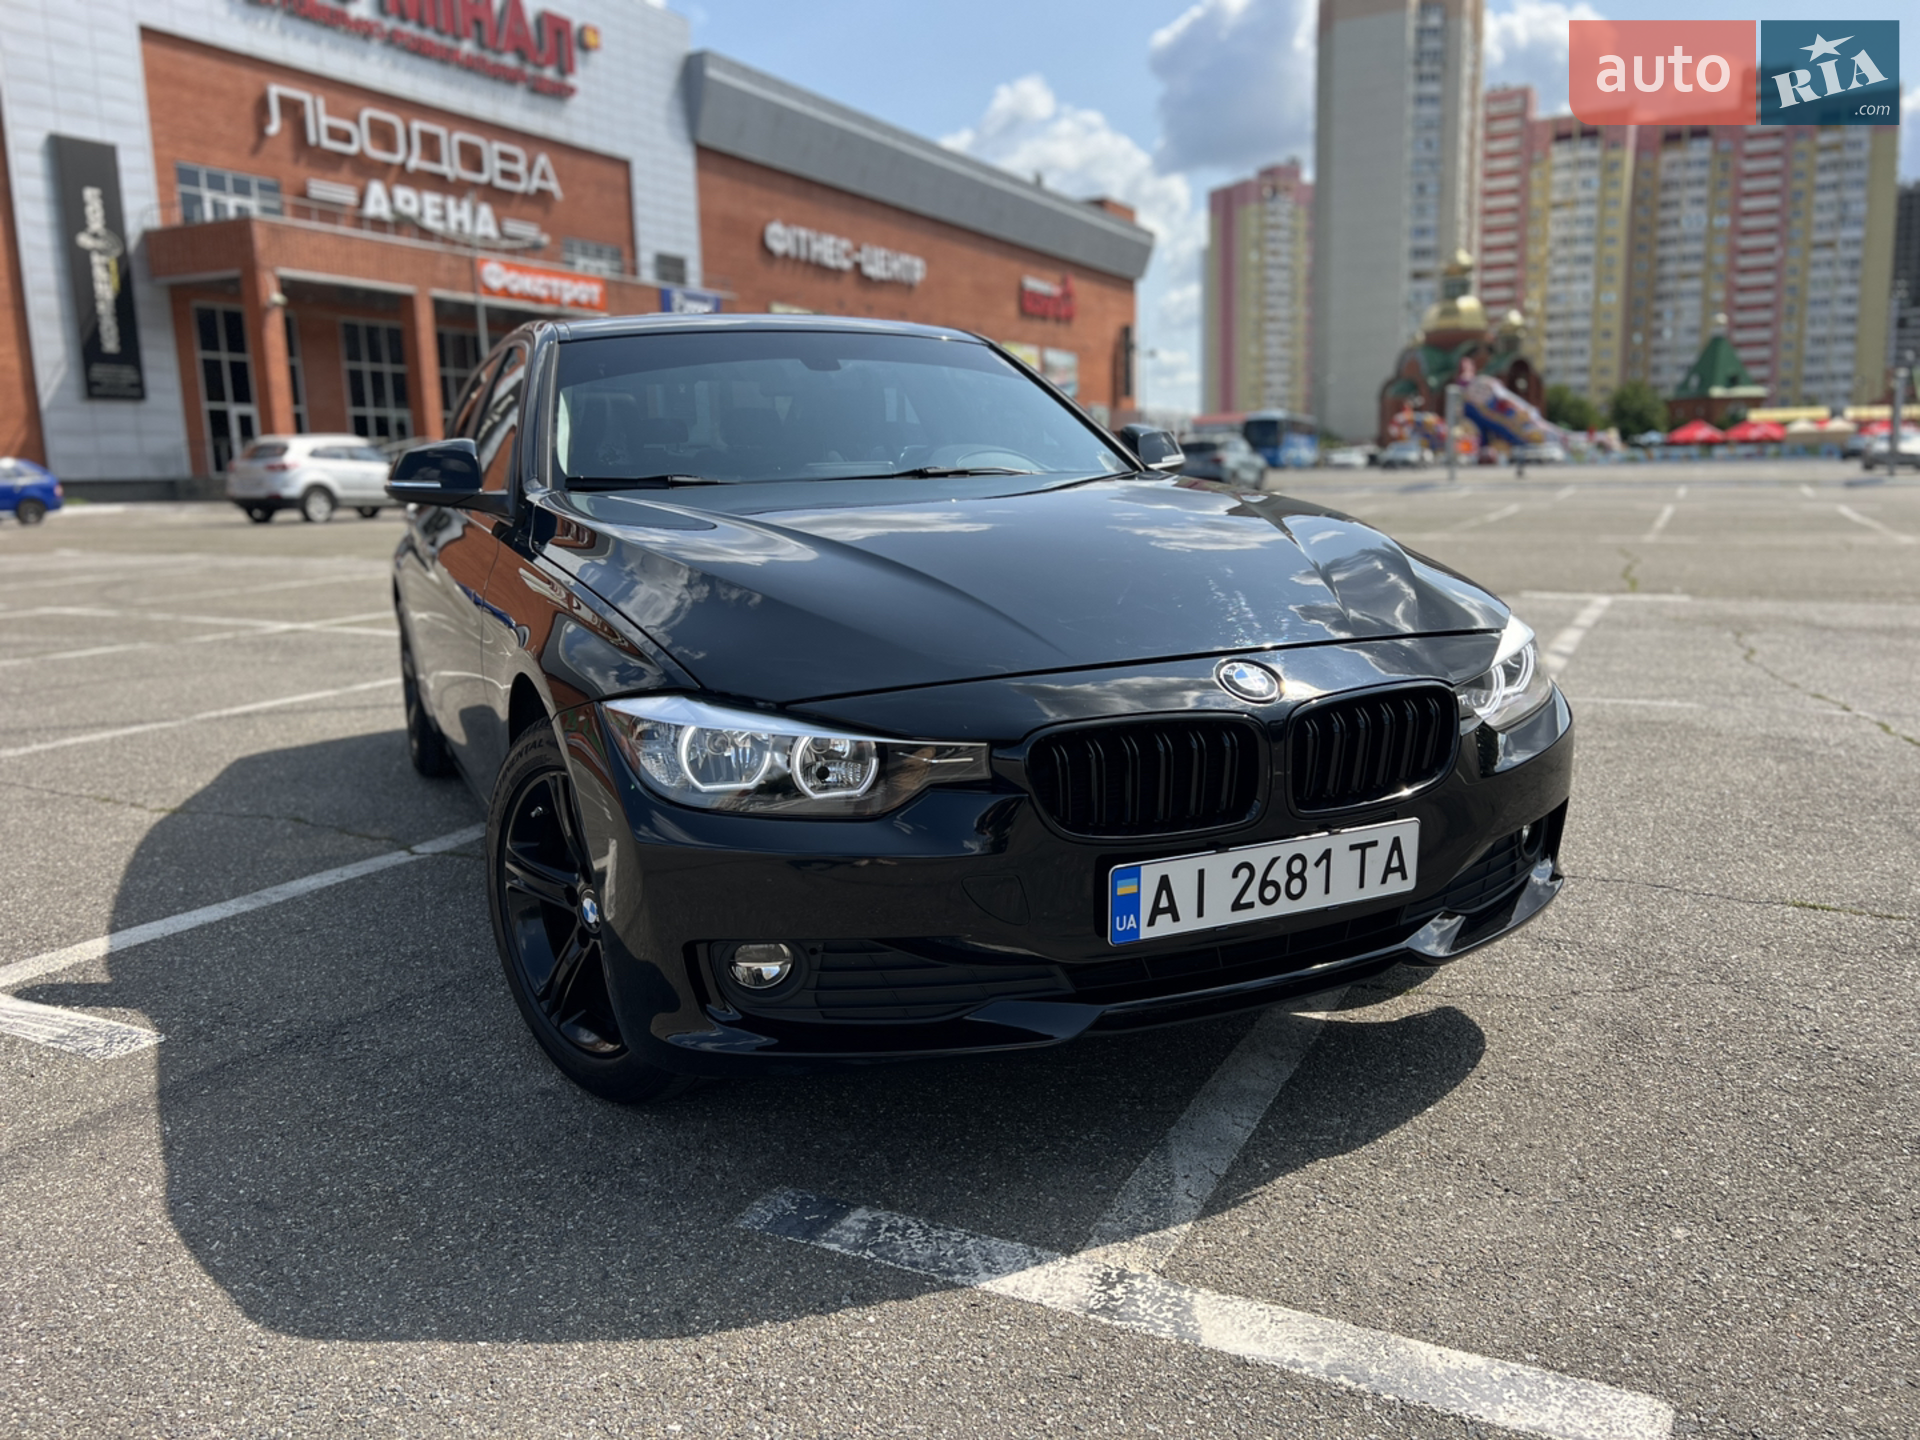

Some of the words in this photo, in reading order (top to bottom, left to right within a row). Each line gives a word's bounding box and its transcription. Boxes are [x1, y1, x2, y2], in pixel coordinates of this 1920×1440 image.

[264, 83, 564, 200] ЛЬОДОВА
[362, 179, 500, 240] АРЕНА
[1146, 867, 1206, 928] AI
[1230, 848, 1333, 912] 2681
[1349, 836, 1408, 889] TA
[1115, 913, 1138, 932] UA
